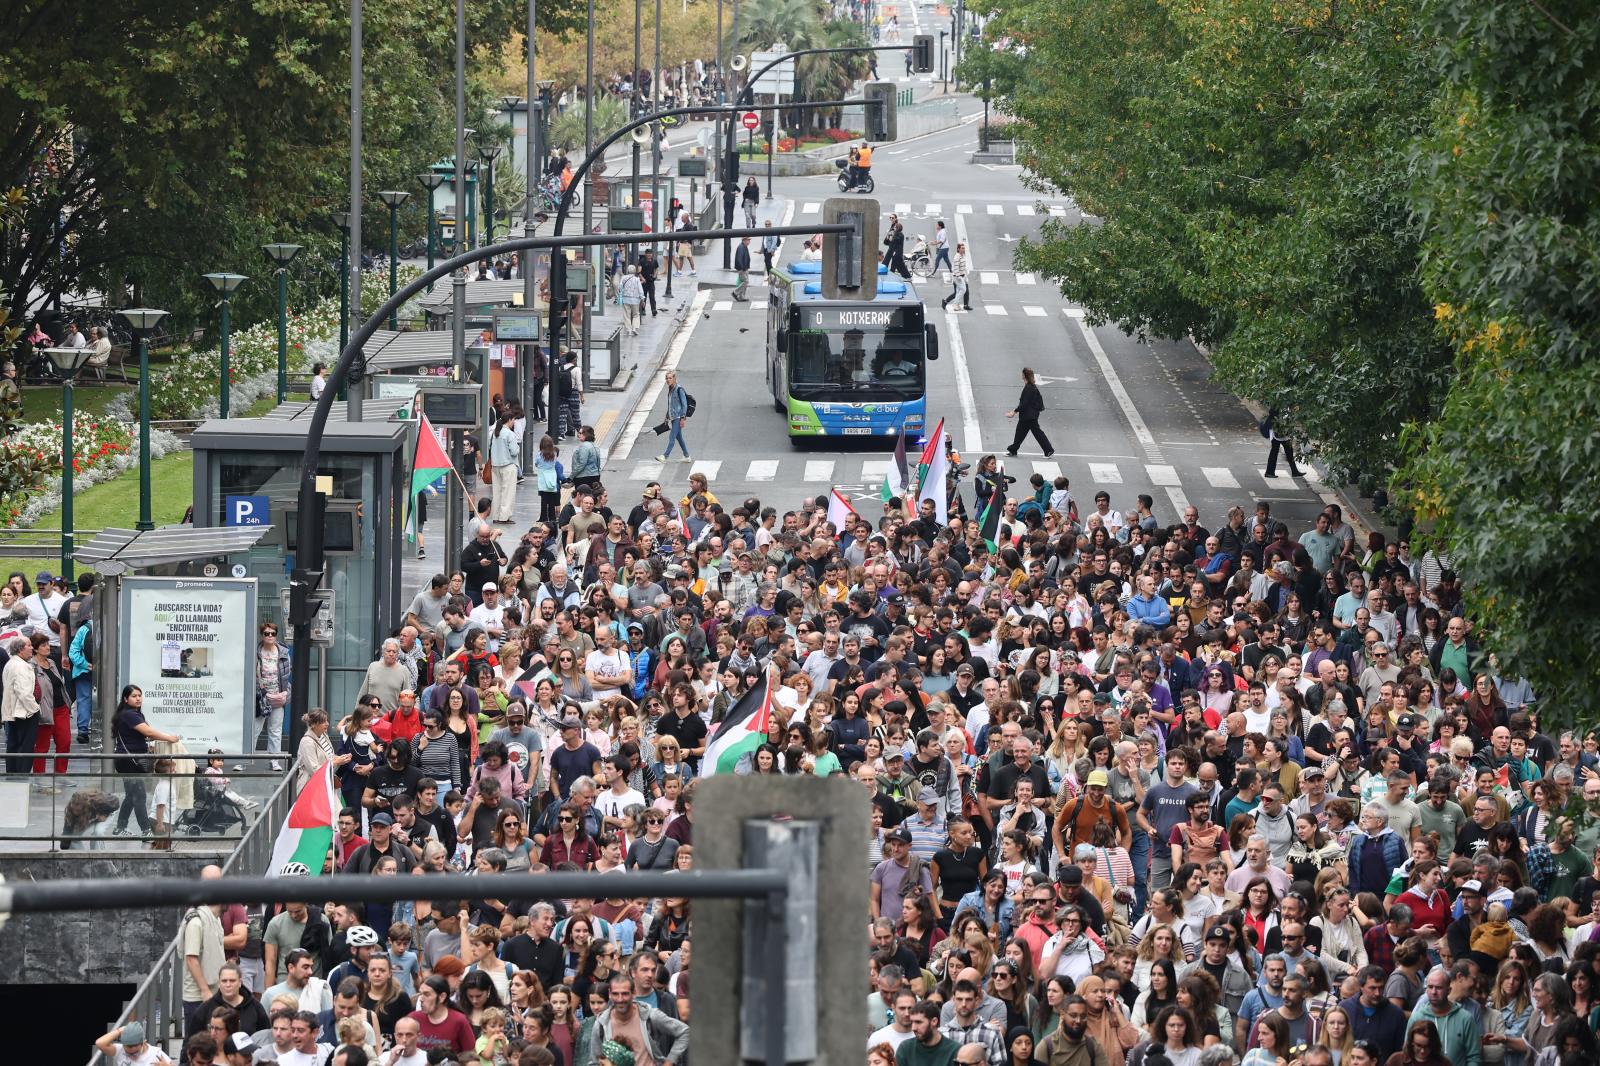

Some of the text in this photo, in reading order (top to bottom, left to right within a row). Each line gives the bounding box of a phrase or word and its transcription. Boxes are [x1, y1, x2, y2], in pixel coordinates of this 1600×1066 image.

[840, 312, 890, 325] KOTXERAK
[236, 500, 254, 524] P
[154, 603, 222, 612] ¿BUSCARSE LA VIDA?
[186, 614, 222, 623] LLAMAMOS
[156, 632, 165, 641] UN
[166, 633, 184, 641] BUEN
